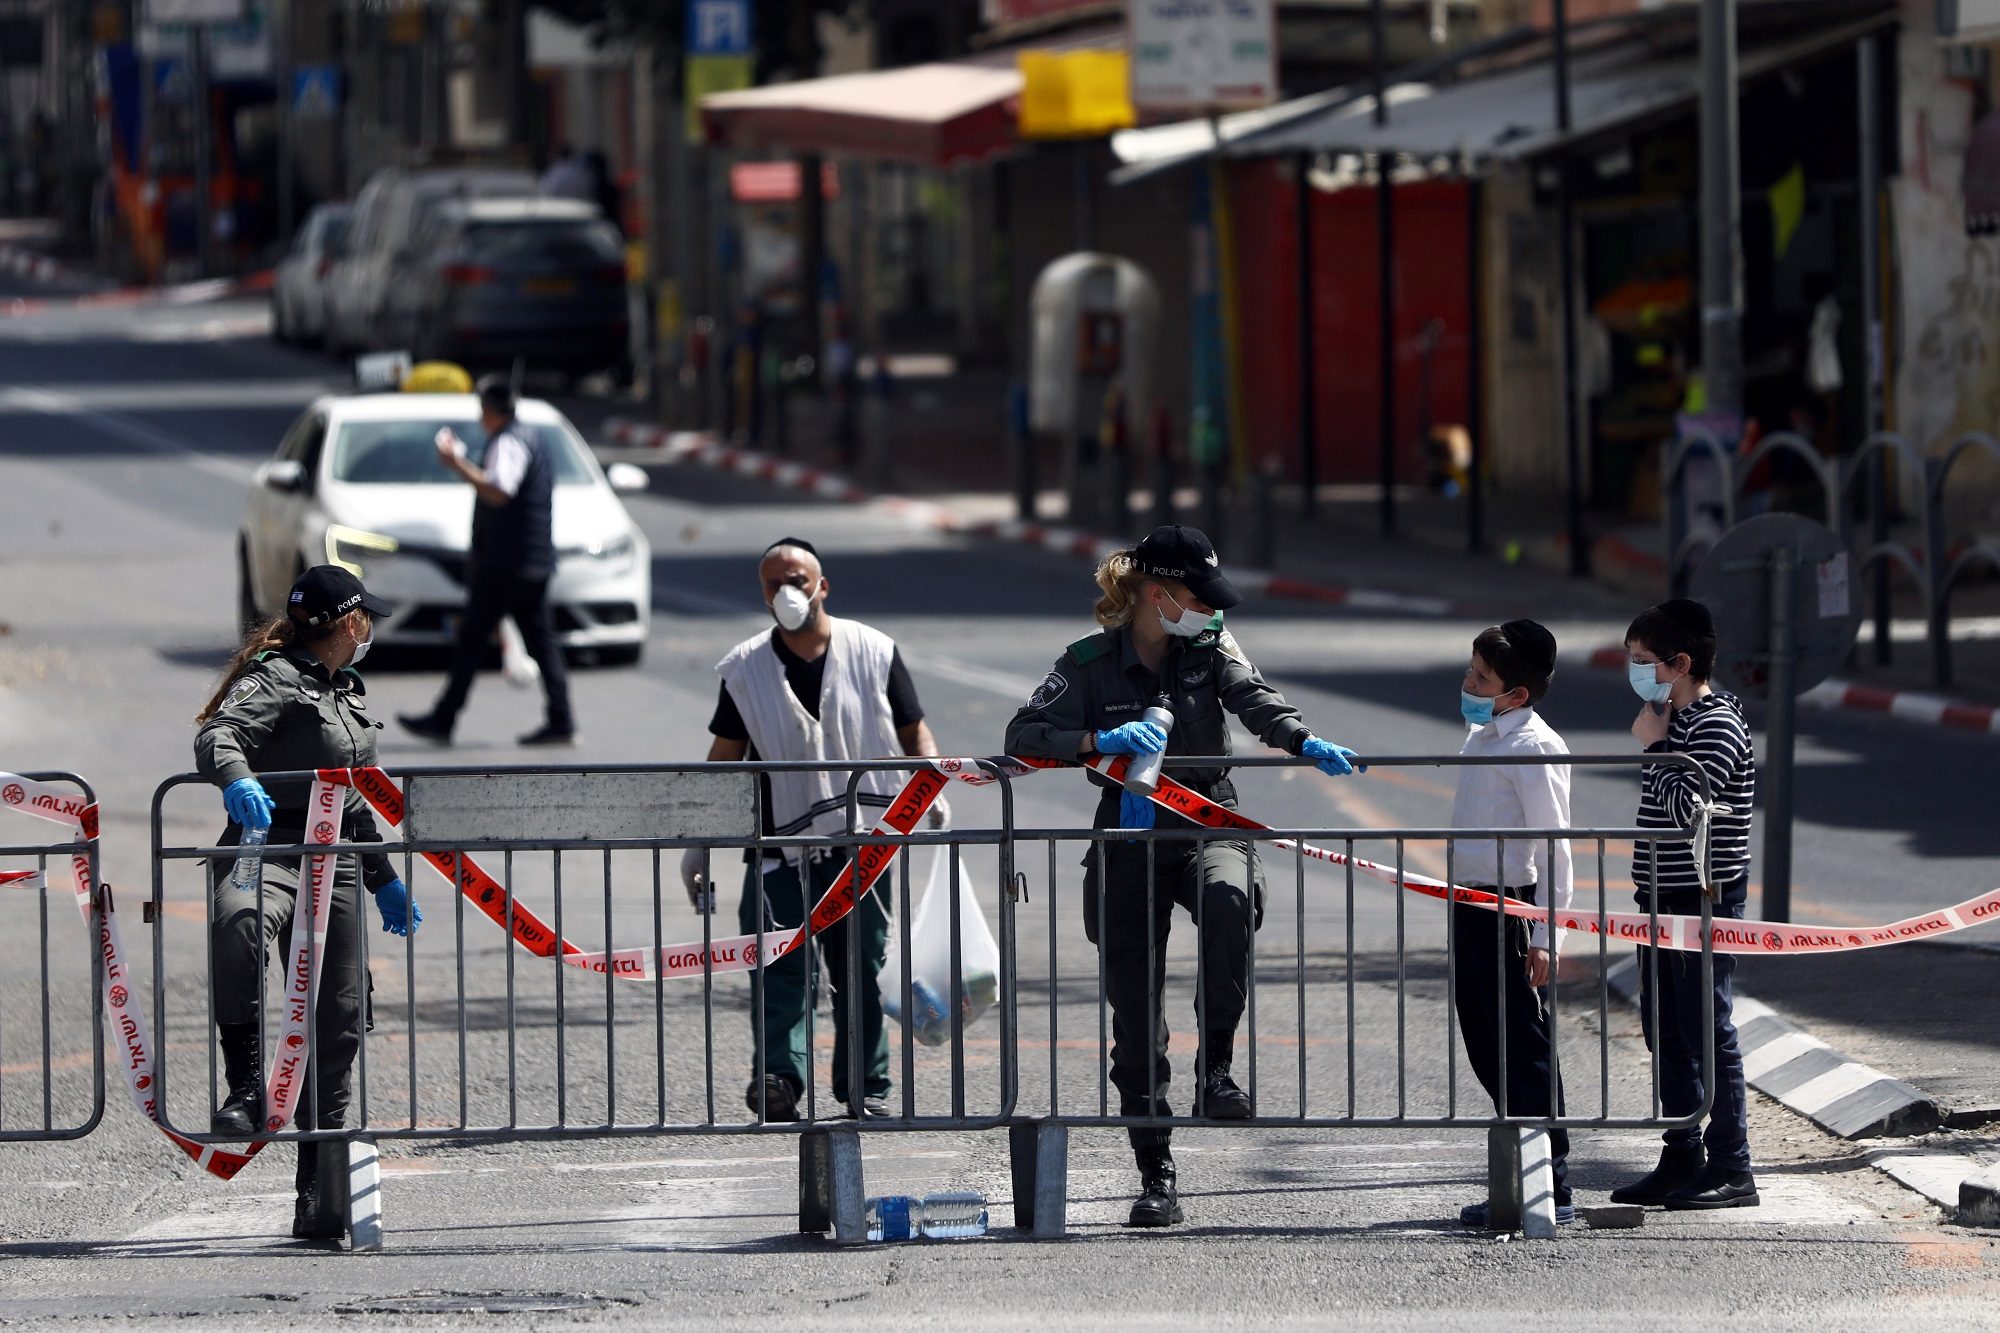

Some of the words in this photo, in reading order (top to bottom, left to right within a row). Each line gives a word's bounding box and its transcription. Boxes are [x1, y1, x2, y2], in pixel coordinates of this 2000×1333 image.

[1153, 567, 1186, 578] POLICE
[337, 593, 362, 613] POLICE
[896, 782, 932, 822] מעבר
[1789, 934, 1842, 947] ישראל
[1872, 929, 1896, 942] אין
[1900, 919, 1950, 937] מעבר
[120, 1014, 147, 1070] ישראל
[273, 1057, 301, 1109] ישראל
[290, 998, 305, 1023] אין
